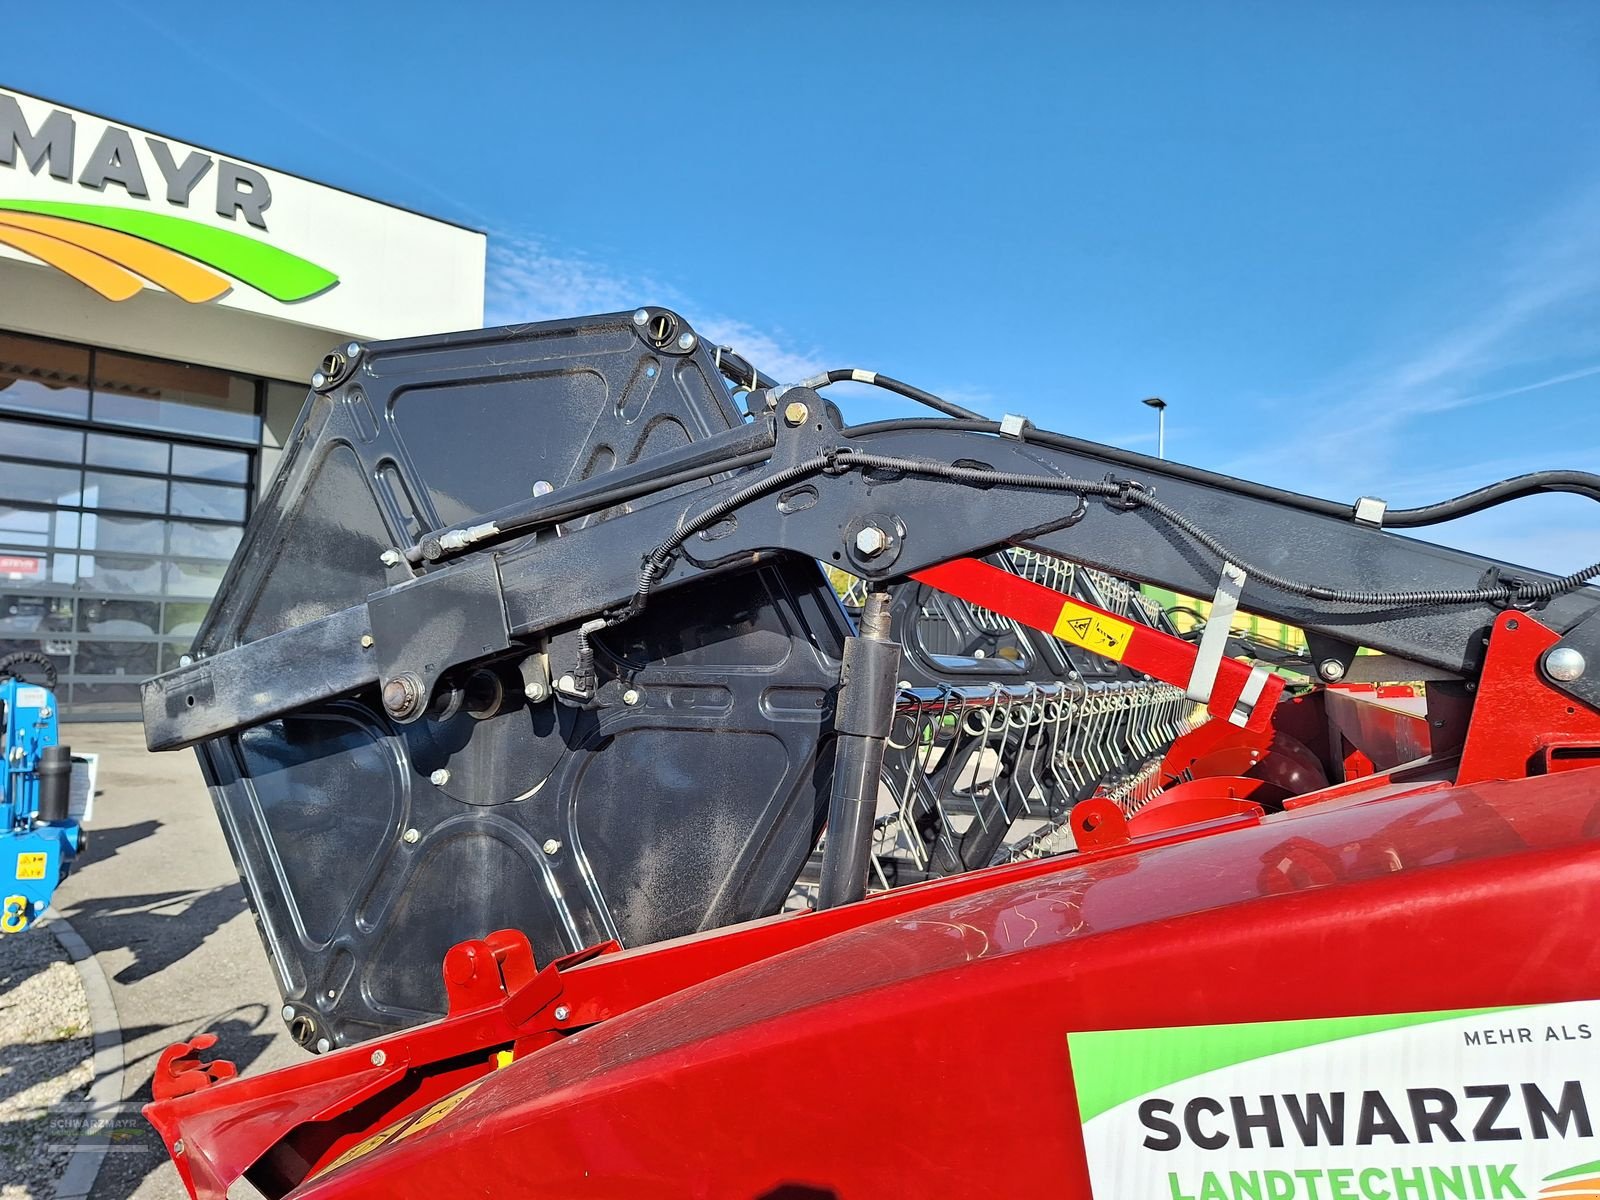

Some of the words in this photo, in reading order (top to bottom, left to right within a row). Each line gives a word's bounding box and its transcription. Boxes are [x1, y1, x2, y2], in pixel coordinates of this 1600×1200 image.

[0, 93, 272, 232] MAYR
[1464, 1028, 1533, 1046] MEHR
[1545, 1024, 1592, 1041] ALS
[1137, 1080, 1594, 1151] SCHWARZM
[1168, 1163, 1527, 1200] LANDTECHNIK
